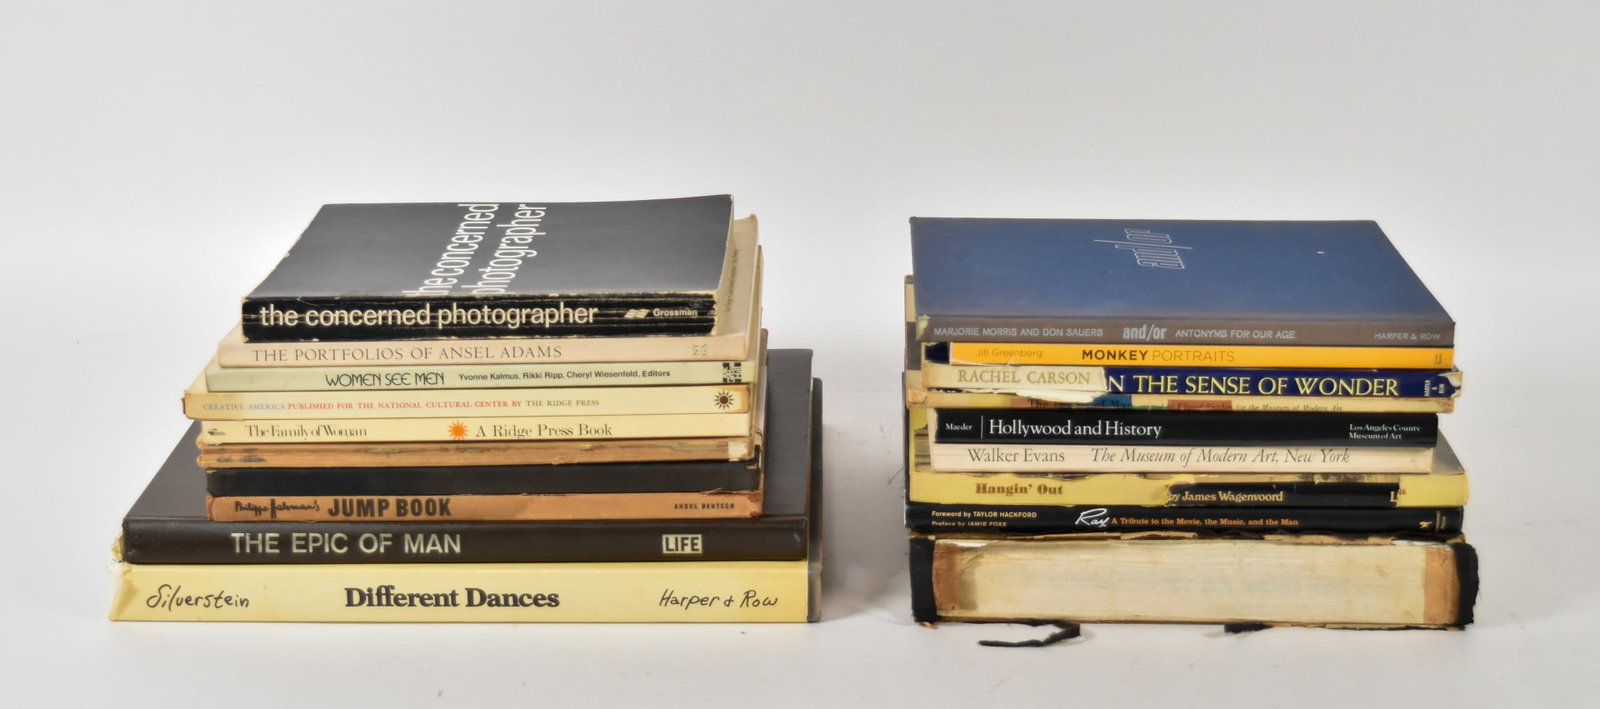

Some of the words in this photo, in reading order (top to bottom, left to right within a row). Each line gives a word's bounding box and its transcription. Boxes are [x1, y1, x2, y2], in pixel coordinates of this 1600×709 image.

[430, 203, 500, 276] concerned
[461, 204, 547, 296] photographer
[260, 303, 298, 327] the
[305, 301, 431, 326] concerned
[437, 302, 598, 329] photographer
[653, 307, 698, 317] Grossman
[934, 327, 979, 336] MARJORIE
[982, 327, 1017, 336] MORRIS
[1020, 327, 1039, 336] AND
[1042, 327, 1063, 336] DON
[1066, 328, 1103, 336] SAUERS
[1122, 324, 1167, 340] and/or
[1175, 329, 1227, 338] ANTONYMS
[1231, 330, 1250, 338] FOR
[1252, 330, 1273, 338] OUR
[1276, 330, 1296, 339] AGE
[1375, 332, 1409, 340] HARPER
[1411, 332, 1418, 340] &
[1420, 332, 1441, 340] ROW
[254, 349, 288, 362] THE
[295, 347, 404, 361] PORTFOLIOS
[410, 347, 433, 360] OF
[439, 346, 495, 360] ANSEL
[500, 345, 562, 358] ADAMS
[976, 348, 989, 357] Jill
[991, 348, 1043, 359] Greenberg
[1082, 349, 1148, 361] MONKEY
[1152, 350, 1235, 362] PORTRAITS
[326, 373, 381, 386] WOMEN
[385, 373, 411, 386] SEE
[415, 372, 445, 385] MEN
[459, 373, 489, 382] Yvonne
[490, 372, 520, 381] Kalmus,
[523, 371, 543, 379] Rikki
[567, 371, 593, 380] Cheryl
[642, 369, 671, 377] Editors
[958, 369, 1021, 384] RACHEL
[1027, 371, 1091, 385] CARSON
[1133, 375, 1178, 392] THE
[1185, 375, 1251, 394] SENSE
[1257, 377, 1288, 395] OF
[1294, 377, 1399, 396] WONDER
[202, 403, 244, 411] CREATIVE
[248, 402, 285, 411] AMERICA
[288, 402, 334, 410] PUBLISHED
[337, 402, 353, 410] FOR
[378, 401, 423, 409] NATIONAL
[576, 399, 600, 407] PRESS
[245, 424, 269, 437] The
[270, 424, 308, 440] Family
[309, 424, 322, 437] of
[323, 424, 367, 437] Woman
[476, 425, 487, 437] A
[493, 423, 532, 439] Ridge
[538, 424, 574, 436] Press
[579, 423, 613, 436] Book
[945, 422, 973, 430] Maeder
[989, 419, 1071, 437] Hollywood
[1074, 420, 1101, 434] and
[1105, 421, 1162, 439] History
[1349, 423, 1364, 432] Los
[1365, 424, 1392, 433] Angeles
[1393, 424, 1420, 433] County
[968, 447, 1020, 462] Walker
[1024, 448, 1065, 462] Evans
[1091, 447, 1115, 462] The
[1120, 448, 1175, 463] Museum
[1180, 447, 1198, 468] of
[1196, 448, 1248, 464] Modern
[1251, 448, 1278, 465] Art,
[1284, 448, 1316, 463] New
[1319, 448, 1351, 464] York
[1037, 483, 1063, 495] Out
[1182, 491, 1216, 501] James
[1218, 491, 1284, 503] Wagenvoord
[328, 498, 390, 517] JUMP
[396, 497, 452, 517] BOOK
[931, 510, 962, 518] Foreword
[964, 511, 971, 520] by
[1075, 508, 1109, 528] Ray
[1111, 517, 1118, 525] A
[1120, 517, 1151, 525] Tribute
[1162, 517, 1174, 525] the
[1176, 518, 1202, 527] Movie,
[1205, 518, 1217, 526] the
[1248, 518, 1263, 526] and
[1266, 518, 1278, 526] the
[1281, 518, 1299, 526] Man
[957, 520, 966, 528] by
[231, 532, 280, 554] THE
[292, 532, 349, 554] EPIC
[358, 532, 393, 554] OF
[404, 532, 462, 554] MAN
[665, 536, 700, 551] LIFE
[147, 584, 249, 612] Silverstein
[344, 586, 459, 608] Different
[465, 588, 560, 608] Dances
[659, 588, 720, 610] Harper
[740, 590, 778, 608] Row
